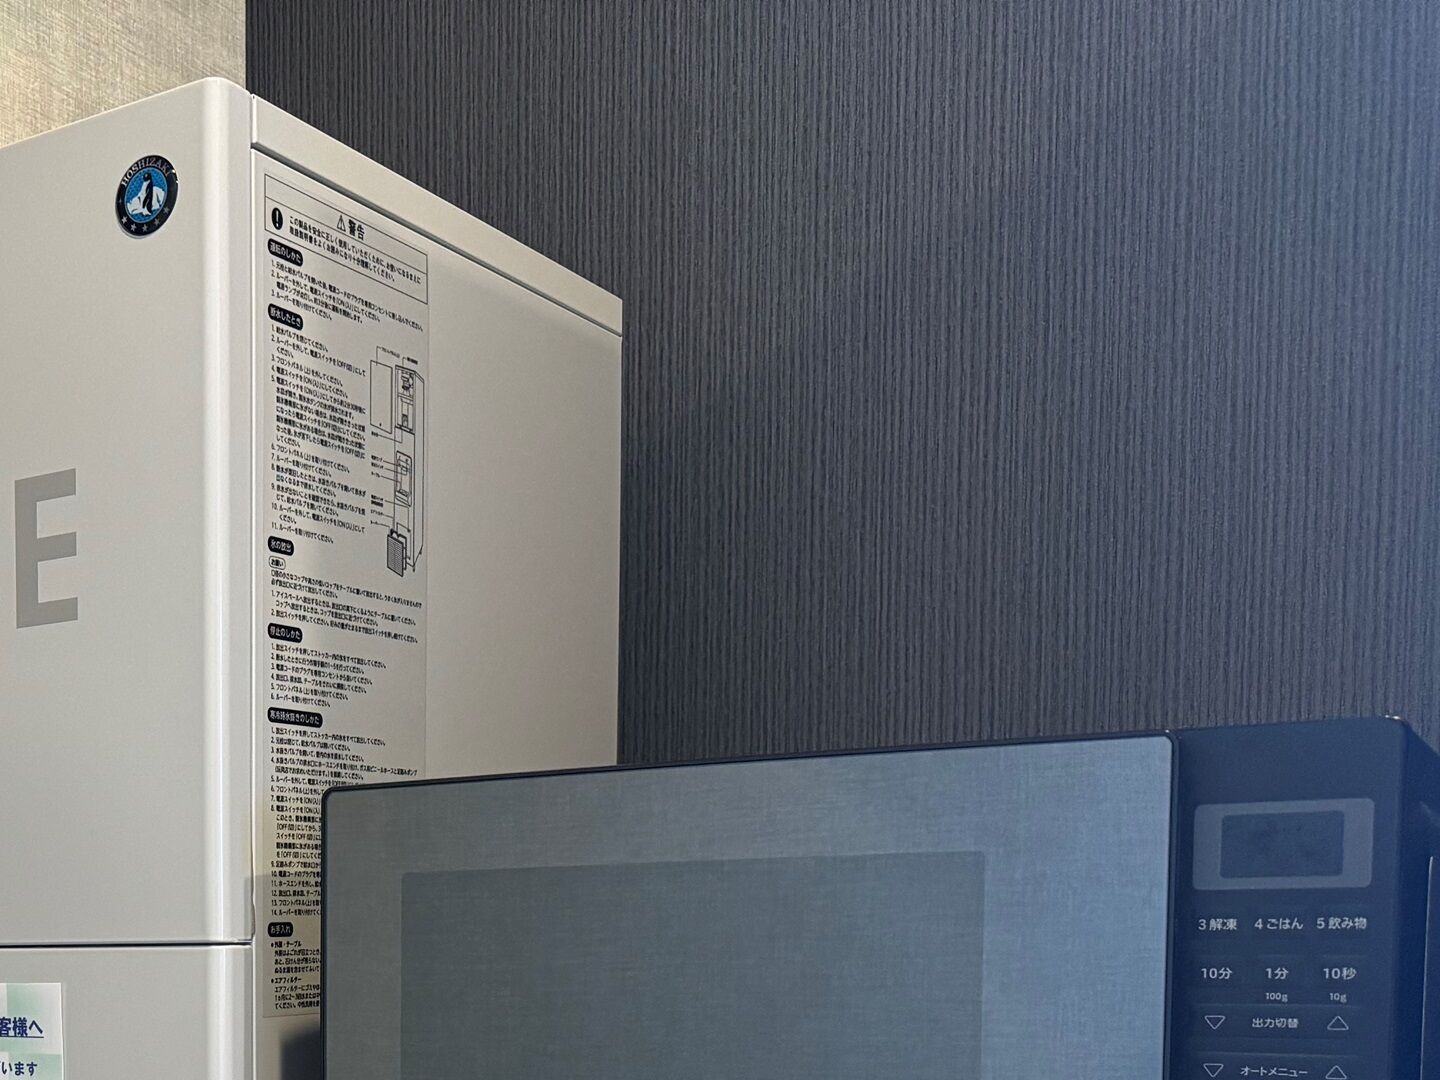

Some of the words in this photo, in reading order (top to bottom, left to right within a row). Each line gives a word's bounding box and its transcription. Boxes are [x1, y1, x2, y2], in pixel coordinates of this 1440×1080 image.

[348, 219, 364, 240] 警告
[270, 625, 300, 640] 停止のしかた
[1199, 919, 1206, 930] 3
[1209, 919, 1237, 931] 解凍
[1254, 919, 1263, 930] 4
[1267, 919, 1304, 930] ごはん
[1317, 918, 1325, 929] 5
[1328, 917, 1367, 930] 飲み物
[1201, 967, 1233, 980] 10分
[1266, 967, 1288, 980] 1分
[1323, 967, 1357, 980] 10秒
[1252, 1017, 1299, 1028] 出力切替
[1240, 1066, 1308, 1078] オートメニュー
